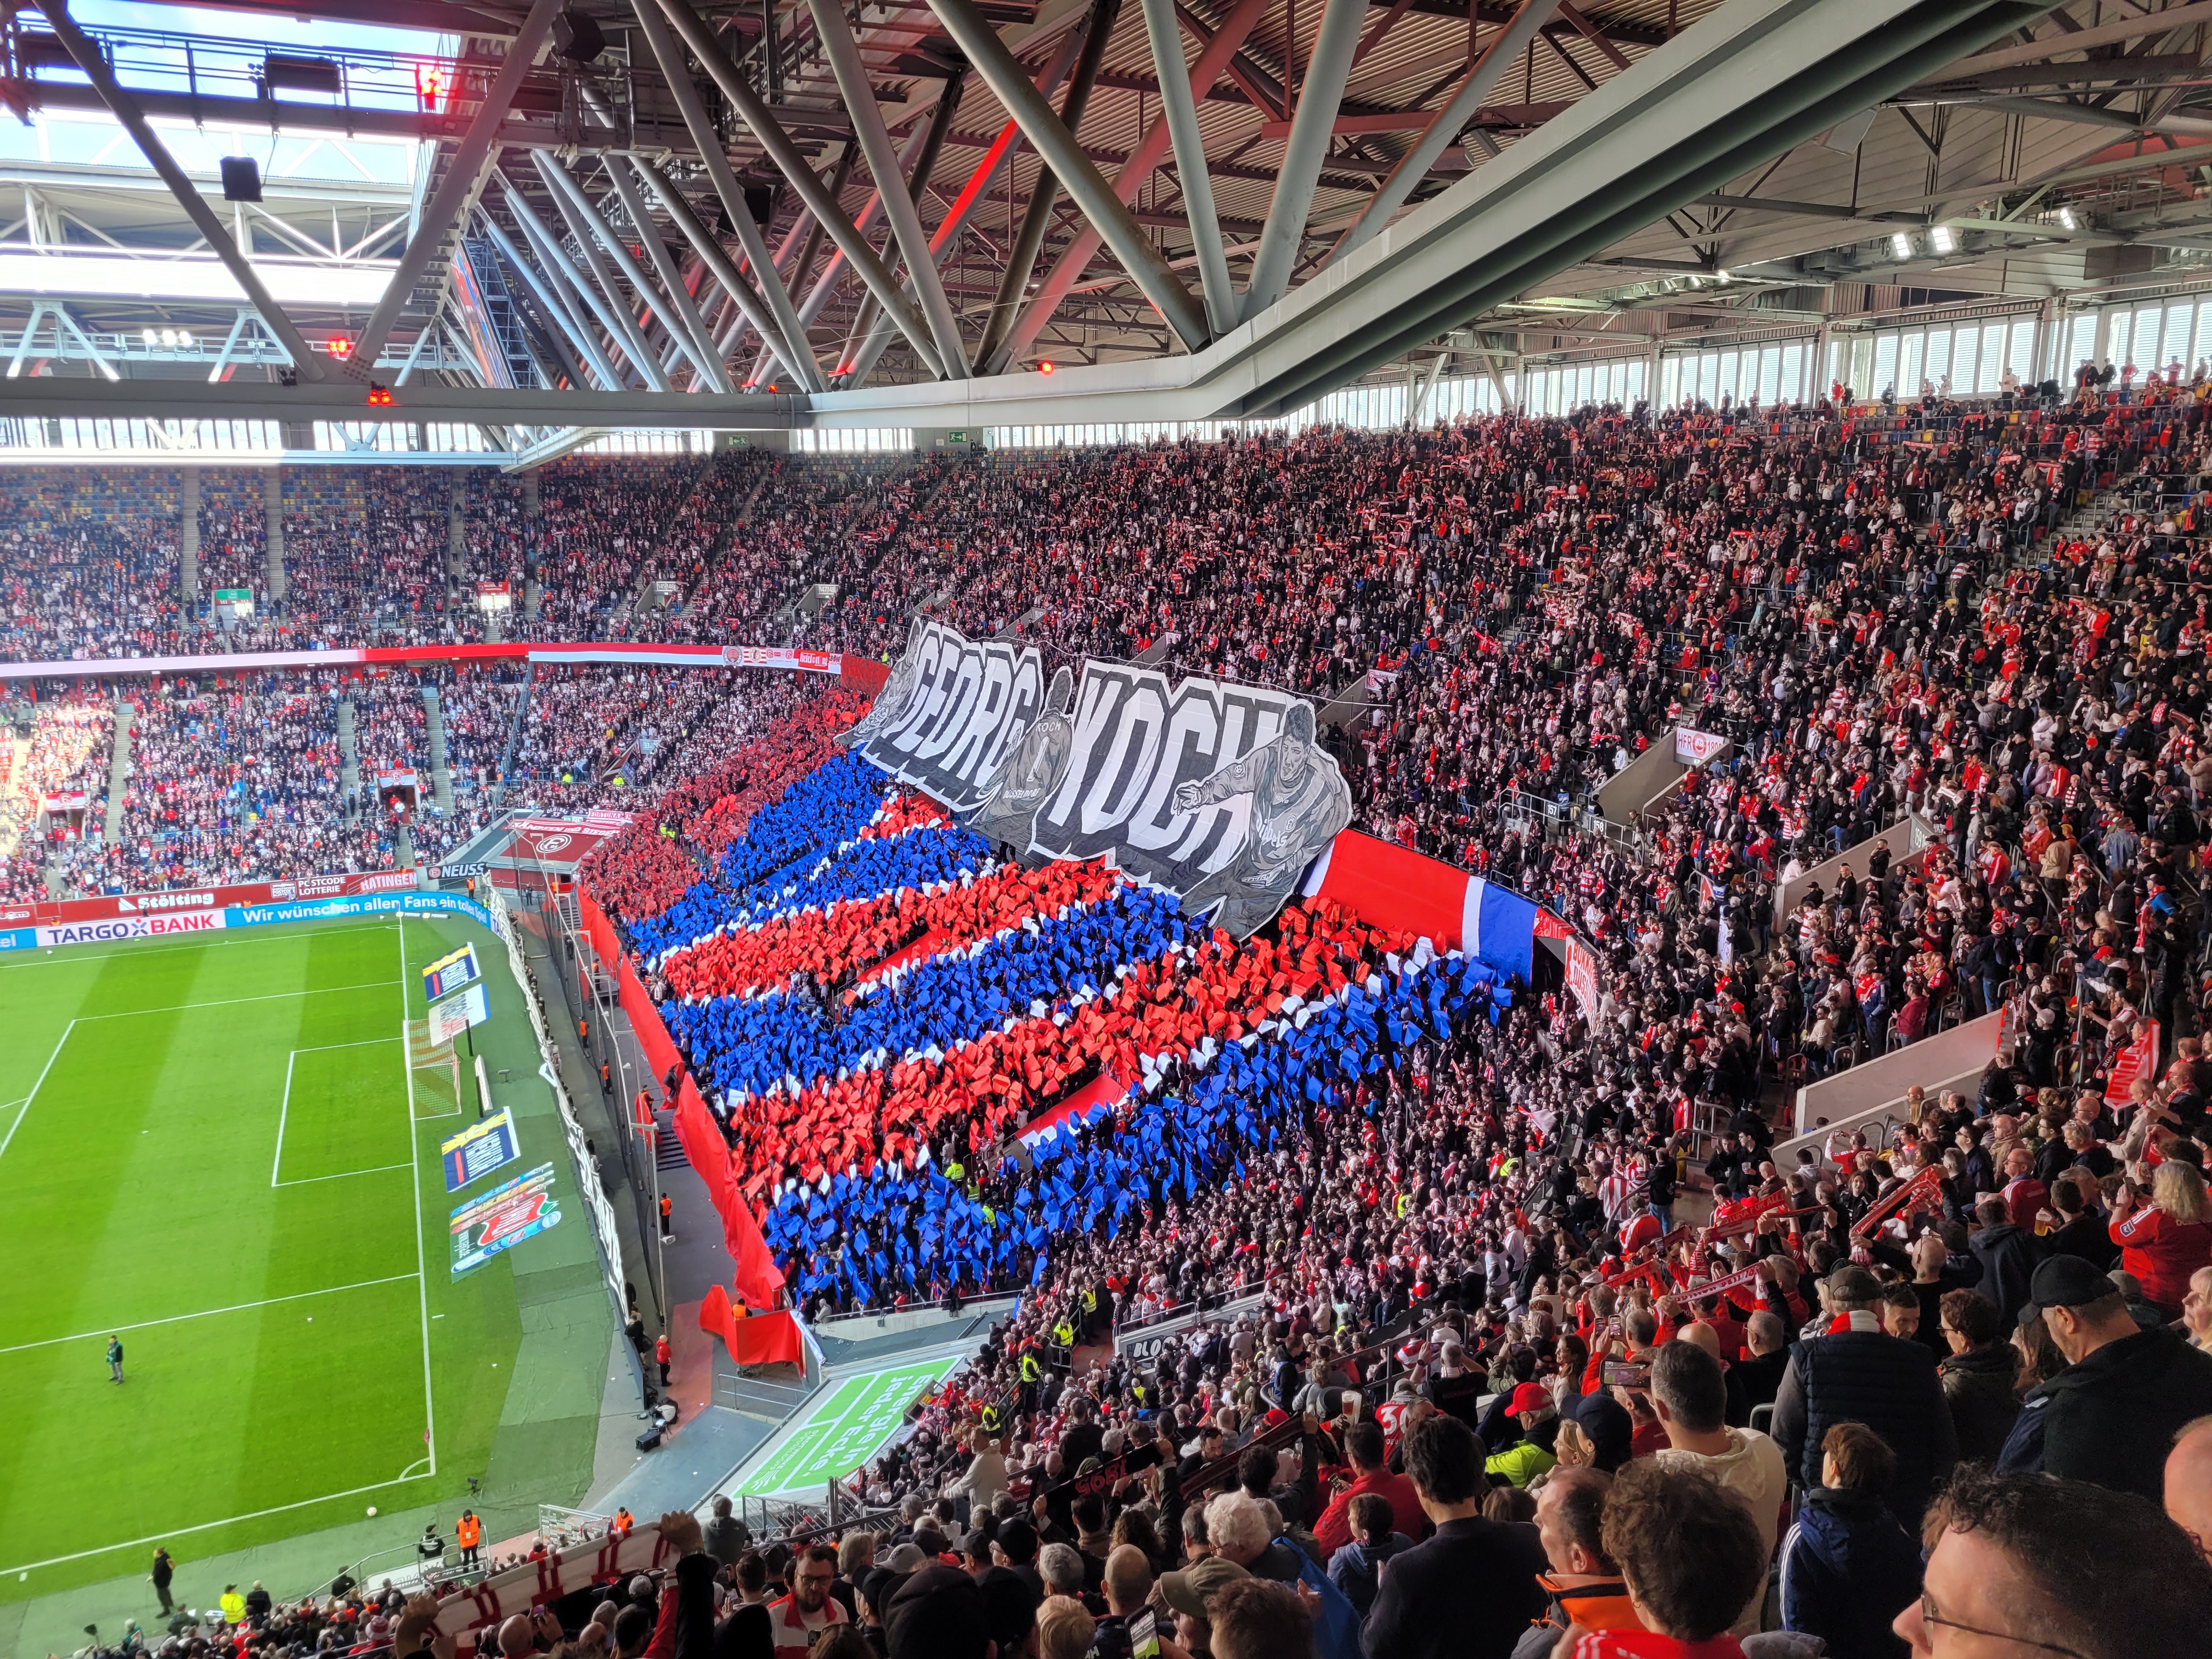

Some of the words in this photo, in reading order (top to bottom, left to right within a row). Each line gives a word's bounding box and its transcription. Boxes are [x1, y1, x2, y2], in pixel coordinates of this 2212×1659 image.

[1036, 722, 1061, 732] KOCH
[1678, 733, 1692, 751] HFR
[881, 634, 1040, 788] GEORG
[1048, 676, 1281, 873] KOCH
[1548, 804, 1557, 816] 157
[512, 821, 563, 832] KÄMPFEN
[1593, 820, 1604, 833] 158
[442, 863, 486, 877] NEUSS
[300, 885, 341, 895] LOTTERIE
[360, 873, 417, 891] RATINGEN
[138, 893, 214, 909] Stölting
[243, 909, 274, 923] Wir
[277, 902, 359, 920] wünschen
[364, 897, 400, 911] allen
[404, 895, 437, 908] Fans
[439, 895, 456, 909] ein
[458, 899, 475, 913] tolles
[473, 906, 487, 924] Spiel
[48, 923, 129, 944] TARGO
[151, 914, 216, 934] BANK
[857, 1375, 913, 1422] jeder
[868, 1374, 934, 1437] Energie
[802, 1426, 865, 1477] Ecke.
[836, 1445, 870, 1467] in
[1076, 1459, 1127, 1495] 1895
